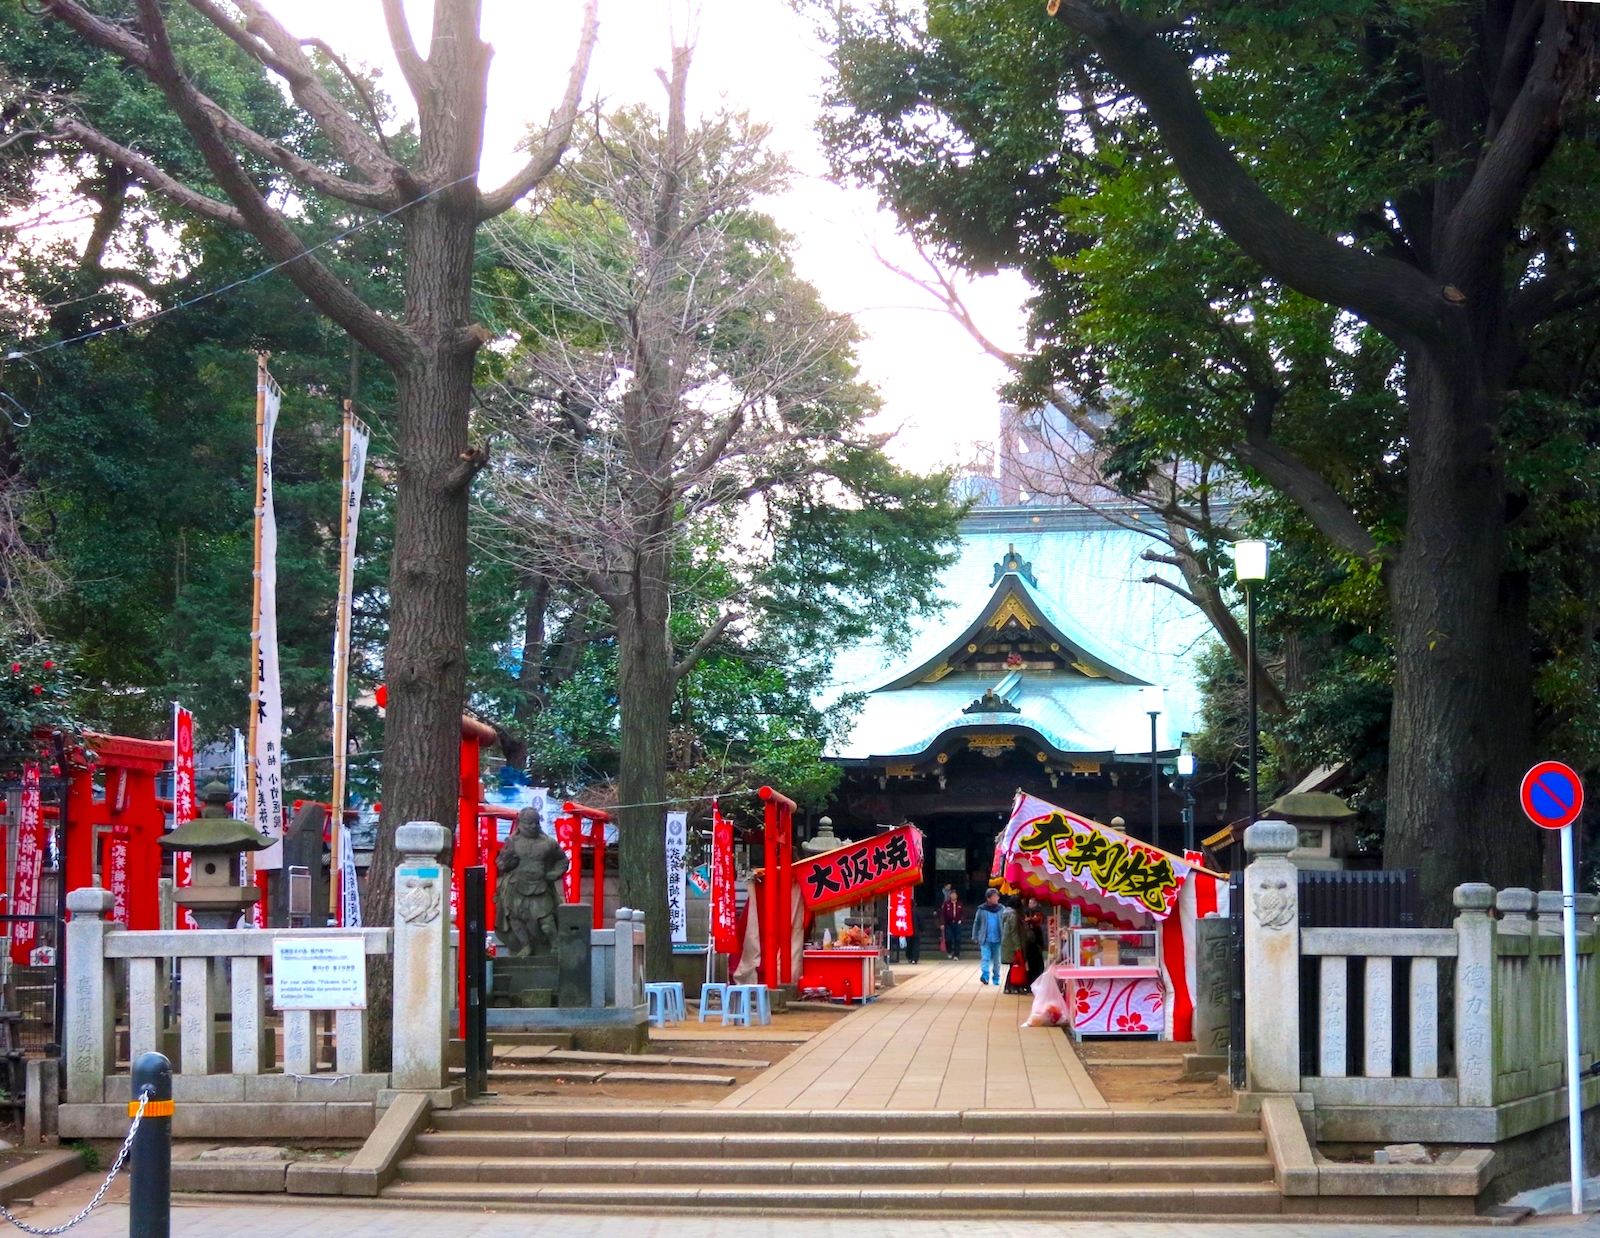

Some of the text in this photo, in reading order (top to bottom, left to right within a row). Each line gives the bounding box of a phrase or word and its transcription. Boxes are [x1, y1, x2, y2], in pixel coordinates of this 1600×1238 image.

[806, 834, 911, 899] 大阪焼
[1018, 811, 1177, 912] 大判焼
[1205, 935, 1230, 1050] 百度石
